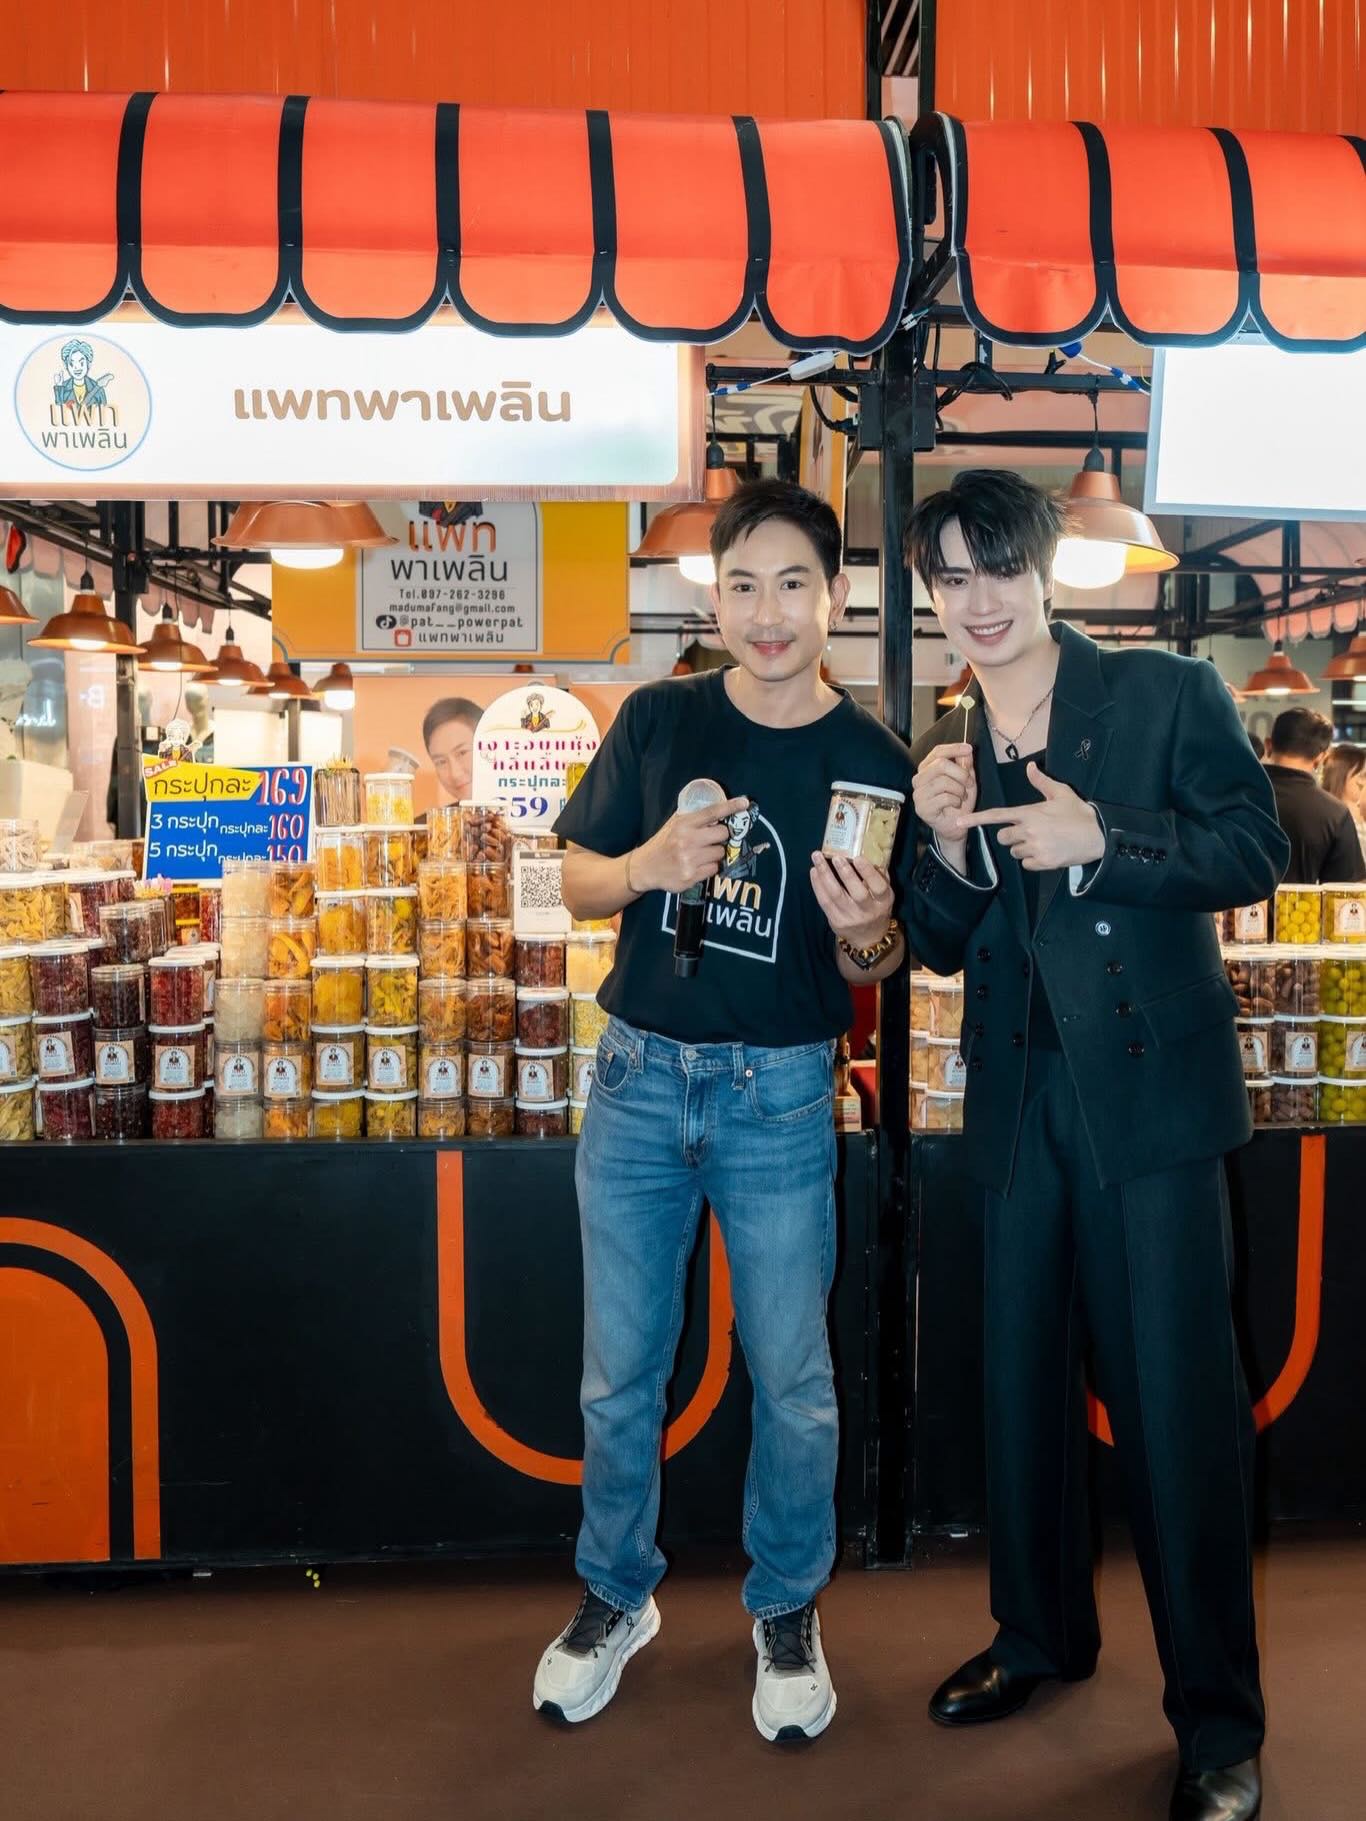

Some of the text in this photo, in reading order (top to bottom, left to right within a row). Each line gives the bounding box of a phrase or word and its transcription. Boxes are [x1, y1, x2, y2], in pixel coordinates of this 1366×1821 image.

[49, 403, 118, 428] แพท
[234, 381, 571, 422] แพทพาเพลิน
[41, 428, 128, 449] พาเพลิน
[408, 520, 496, 553] แพท
[391, 554, 509, 583] พาเพลิน
[418, 630, 504, 644] แพทพาเพลิน
[154, 767, 308, 806] กระปุกละ 169
[151, 811, 304, 840] 3 กระปุก กระปุกละ 160
[149, 842, 161, 858] 5
[166, 840, 218, 862] กระปุก
